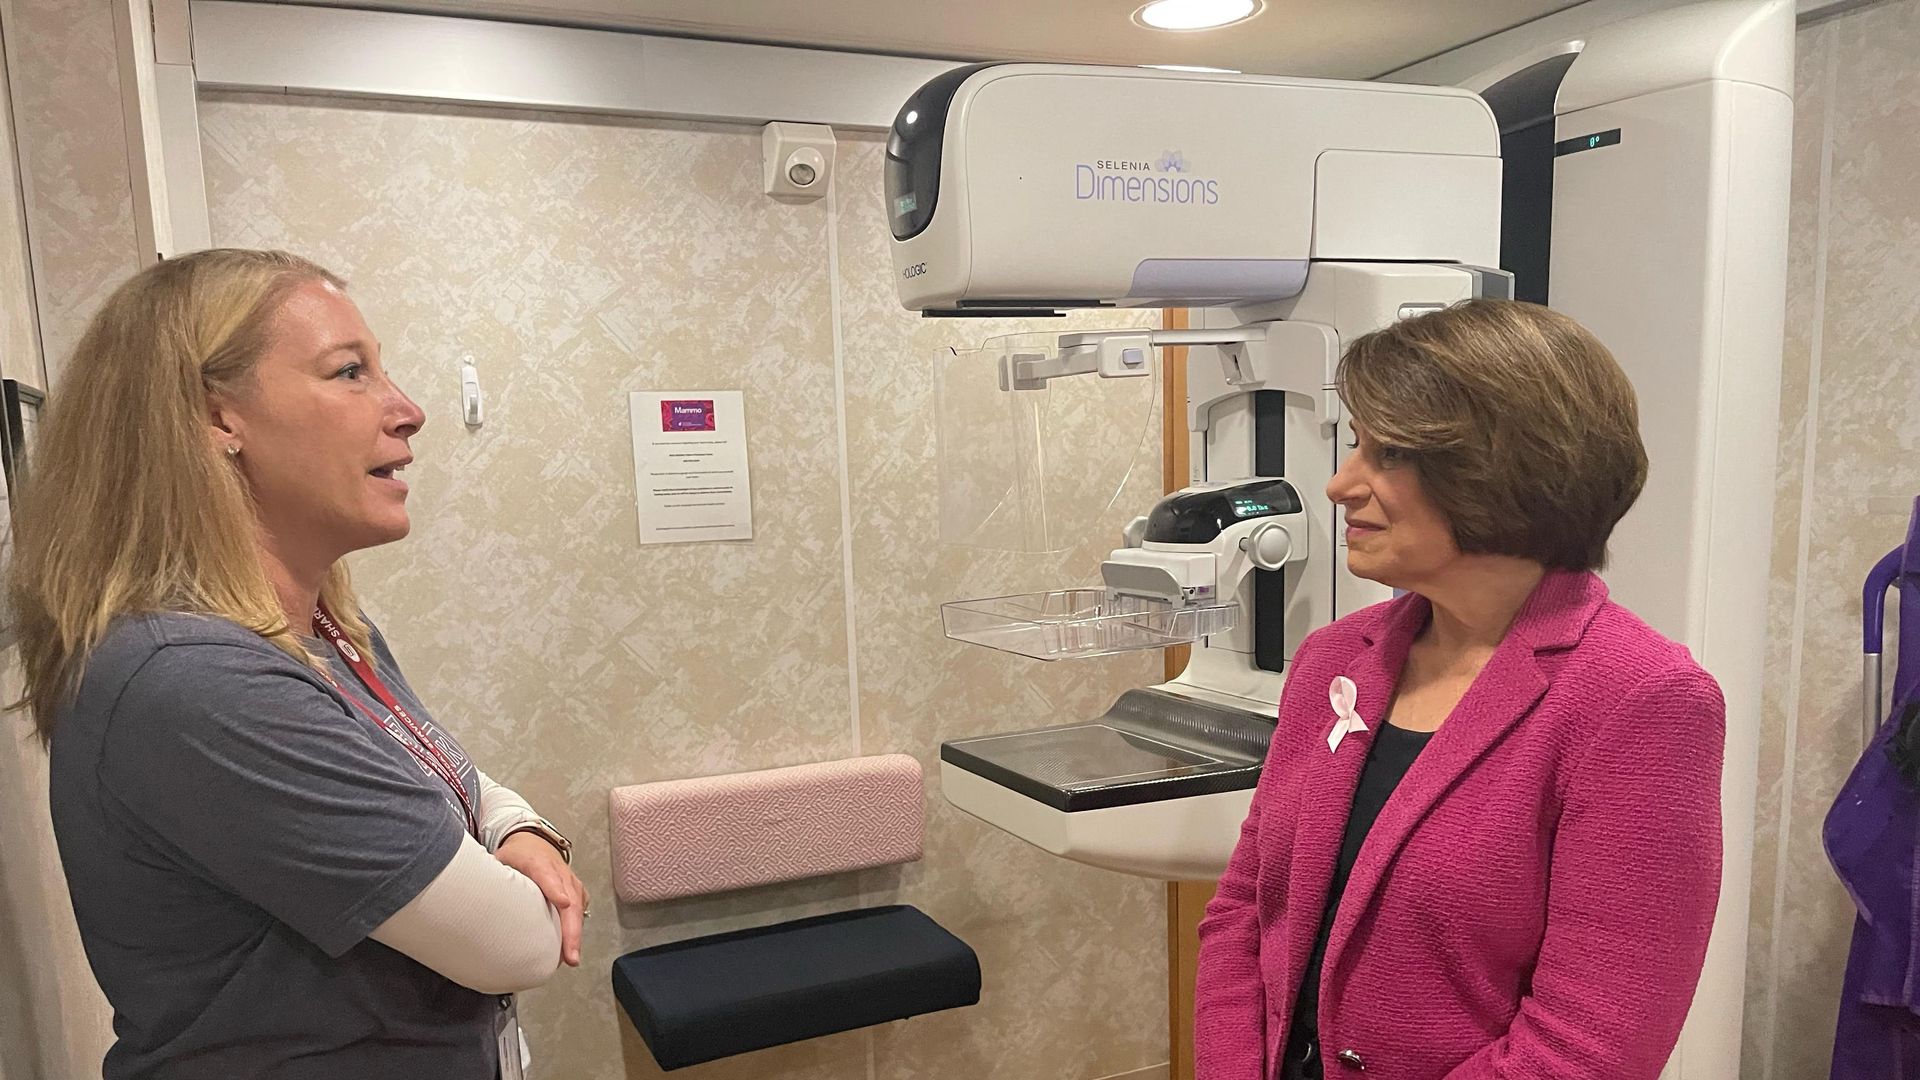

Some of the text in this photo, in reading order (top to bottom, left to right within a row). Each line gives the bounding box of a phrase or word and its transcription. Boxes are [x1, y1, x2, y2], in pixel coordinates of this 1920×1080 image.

[1097, 160, 1150, 171] SELENIA
[1076, 164, 1219, 205] Dimensions
[674, 406, 703, 414] Mammo
[393, 704, 434, 749] SERVICES
